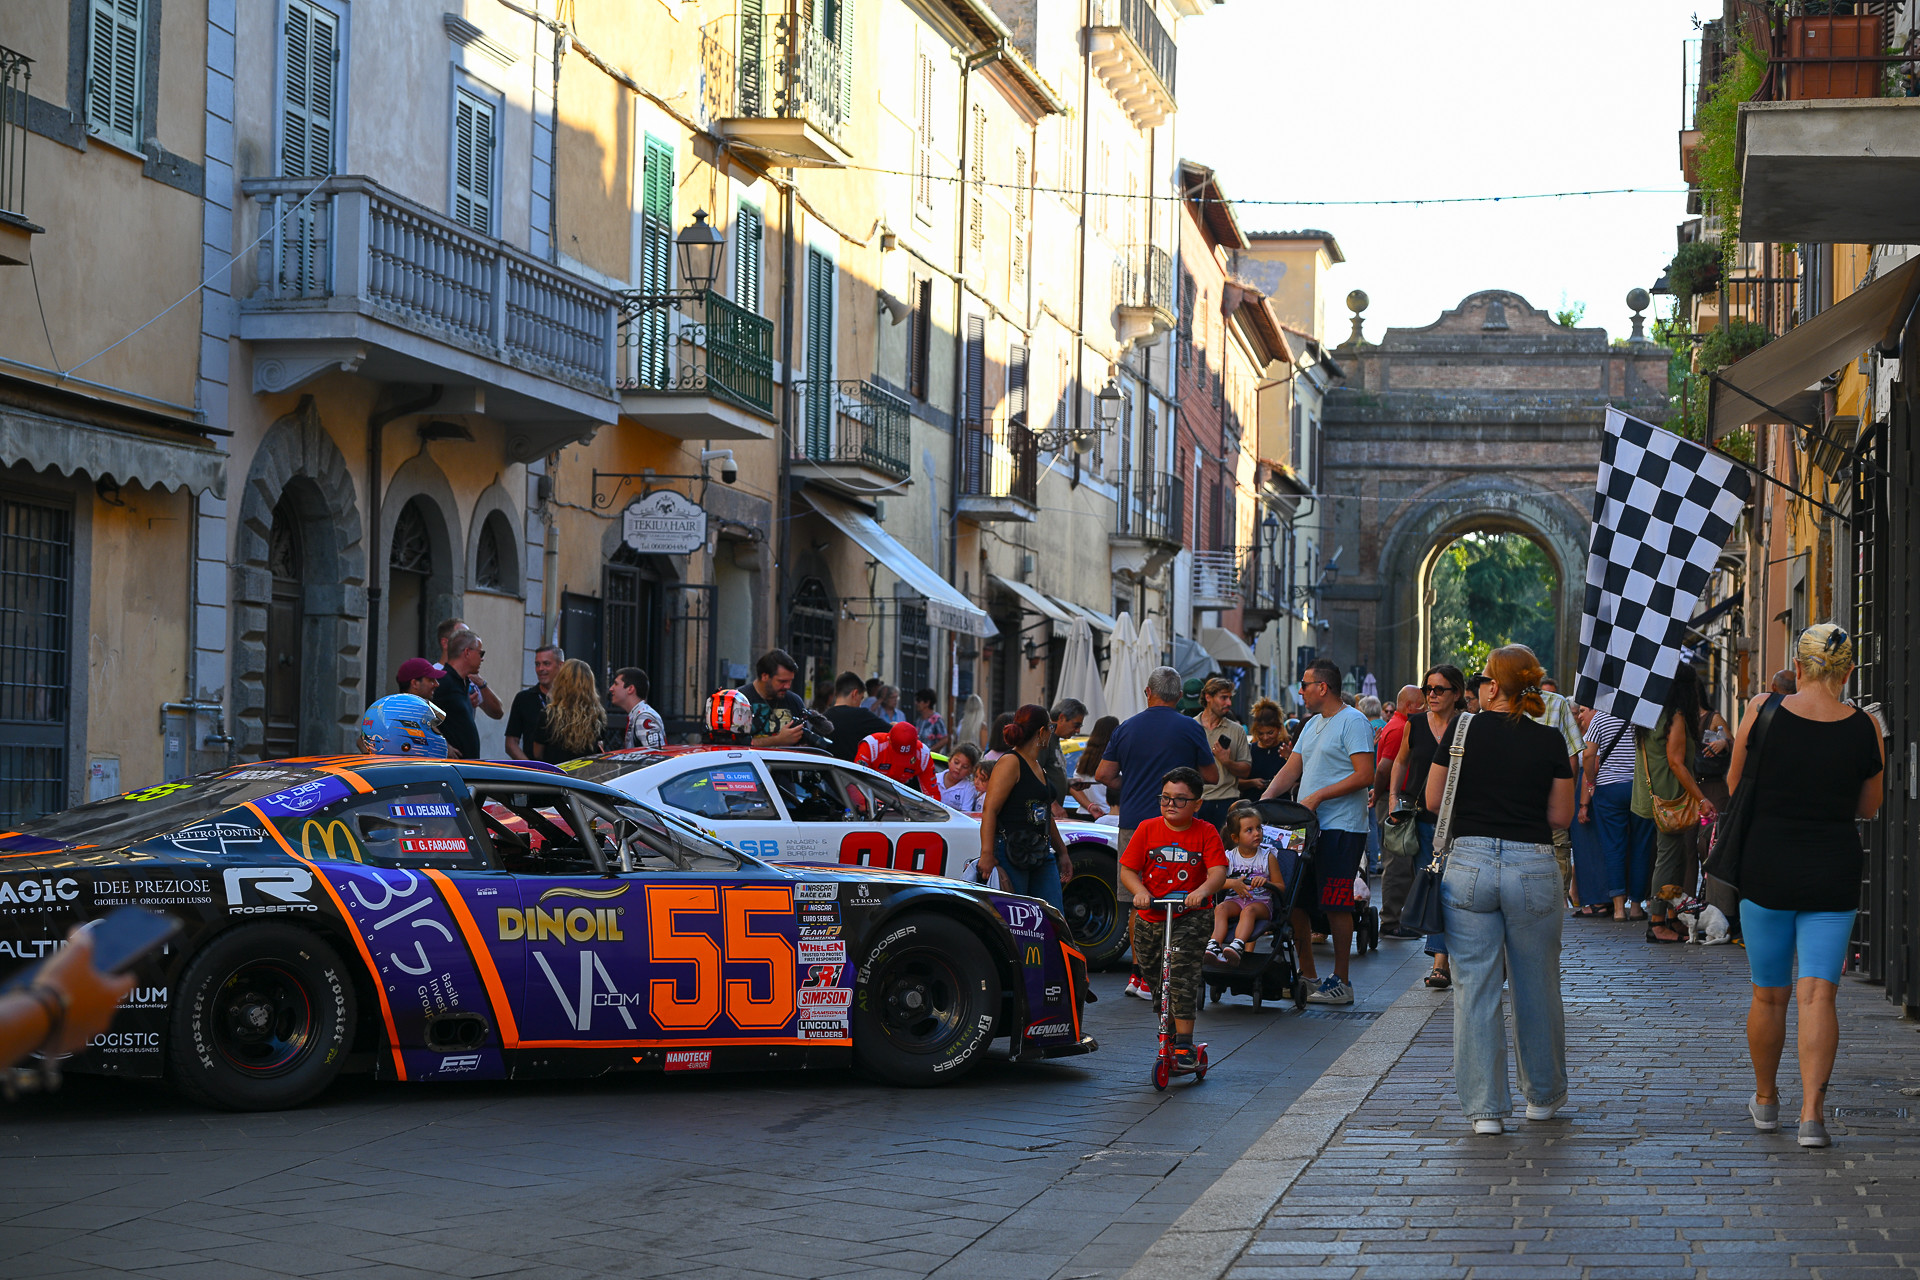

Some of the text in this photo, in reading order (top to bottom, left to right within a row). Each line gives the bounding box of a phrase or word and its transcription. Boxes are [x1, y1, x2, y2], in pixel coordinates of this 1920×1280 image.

[669, 520, 696, 532] HAIR
[1444, 762, 1459, 805] VALENTINO
[265, 782, 327, 805] LA DEA
[406, 805, 452, 816] U. DELSAUX
[163, 827, 270, 842] ELETTROPONTINA
[427, 840, 466, 851] FARAONIO
[724, 840, 779, 857] SB
[93, 879, 211, 895] IDEE PREZIOSE
[808, 884, 833, 892] NASCAR
[1325, 876, 1352, 888] SUPE
[94, 898, 128, 906] GIOIELLI
[139, 897, 175, 905] OROLOGI
[186, 896, 212, 904] LUSSO
[1320, 886, 1355, 906] RIFL
[228, 904, 318, 915] ROSSETTO
[497, 905, 625, 947] DINOIL
[643, 883, 797, 1031] 55
[429, 979, 448, 1014] Invest
[441, 973, 459, 1007] Basile
[801, 991, 848, 1005] SIMPSON
[800, 1021, 839, 1030] LINCOLN
[1026, 1023, 1071, 1036] KENNOL
[86, 1033, 160, 1047] LOGISTIC
[666, 1051, 710, 1062] NANOTECH
